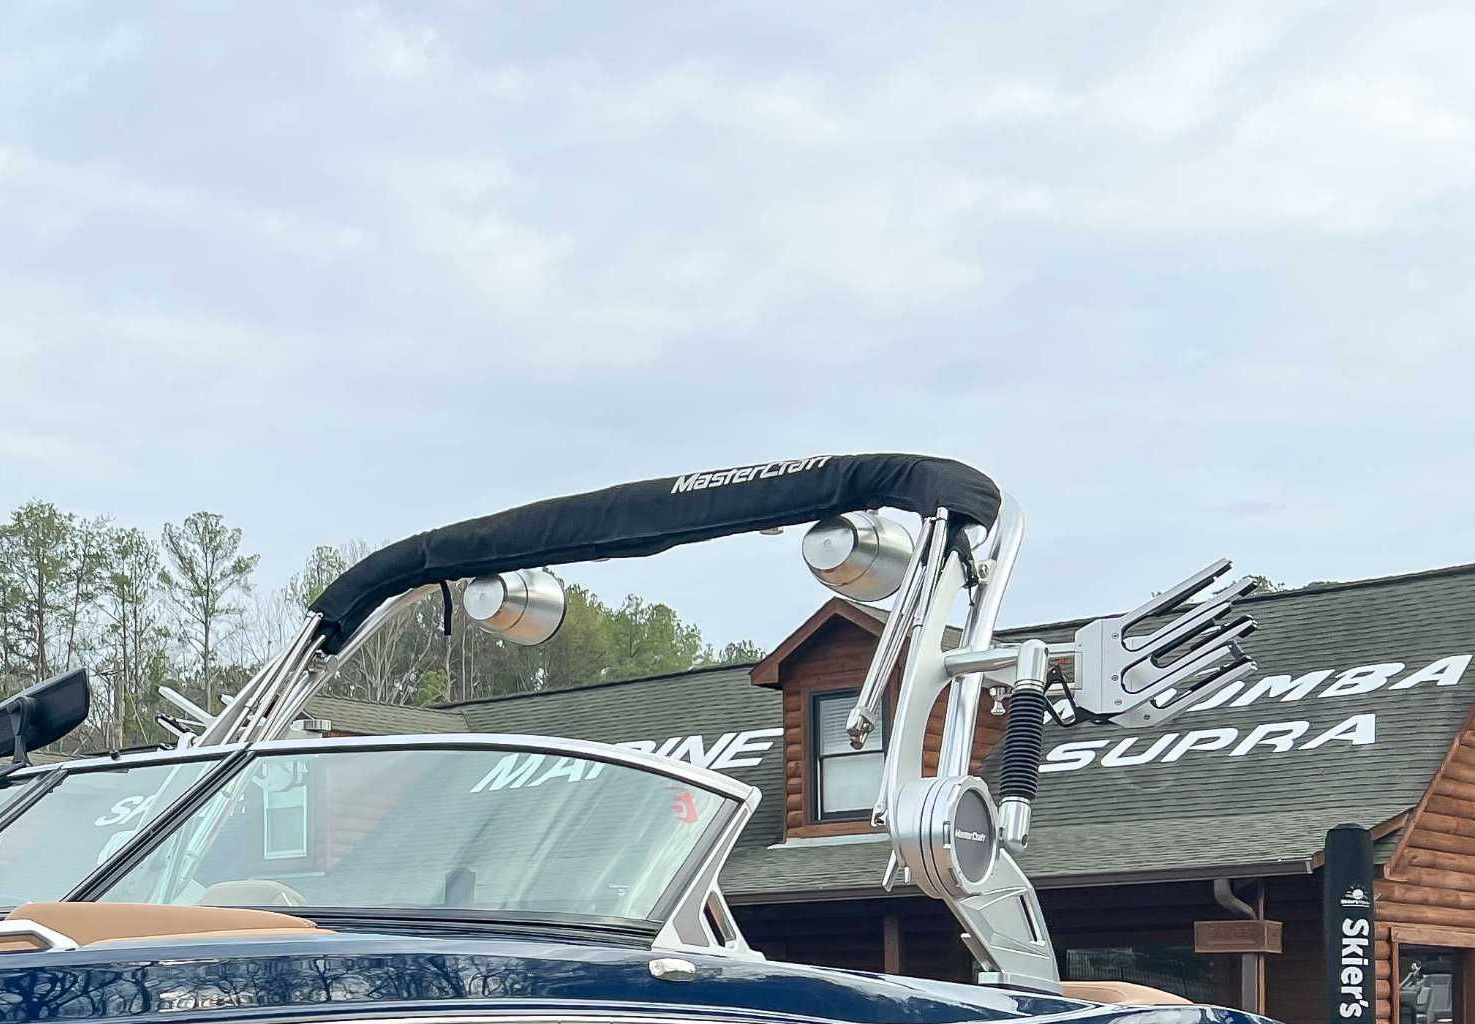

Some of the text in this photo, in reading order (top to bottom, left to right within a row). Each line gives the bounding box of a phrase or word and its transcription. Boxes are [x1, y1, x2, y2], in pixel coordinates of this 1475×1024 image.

[670, 455, 831, 495] MasterCraft
[1038, 713, 1375, 773] SUPRA
[1340, 918, 1370, 1018] Skier's
